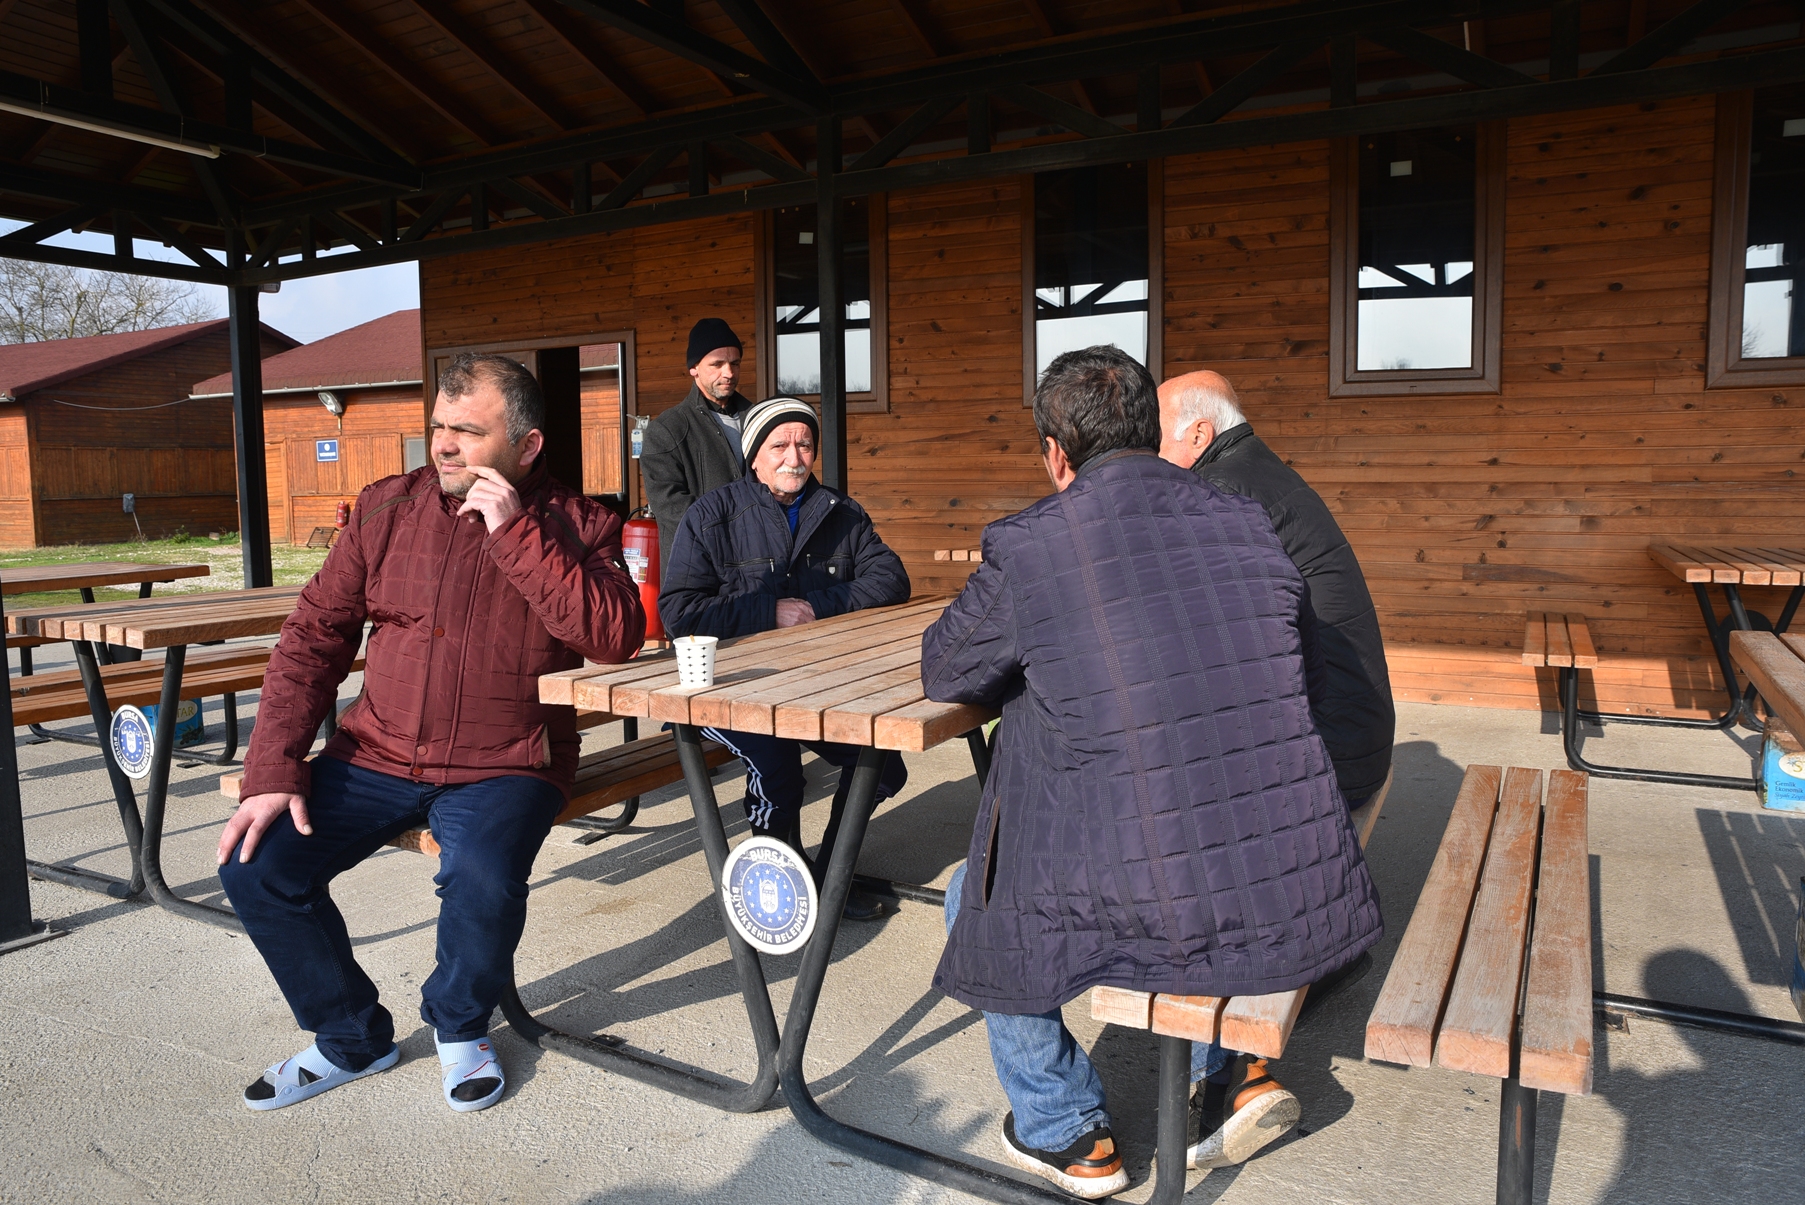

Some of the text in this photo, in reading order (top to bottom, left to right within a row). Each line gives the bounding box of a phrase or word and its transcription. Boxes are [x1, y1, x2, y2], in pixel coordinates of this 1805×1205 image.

[121, 711, 139, 723] BURSA
[177, 706, 195, 718] TAR
[749, 849, 789, 867] BURSA
[731, 886, 773, 943] BÜYÜKŞEHİR
